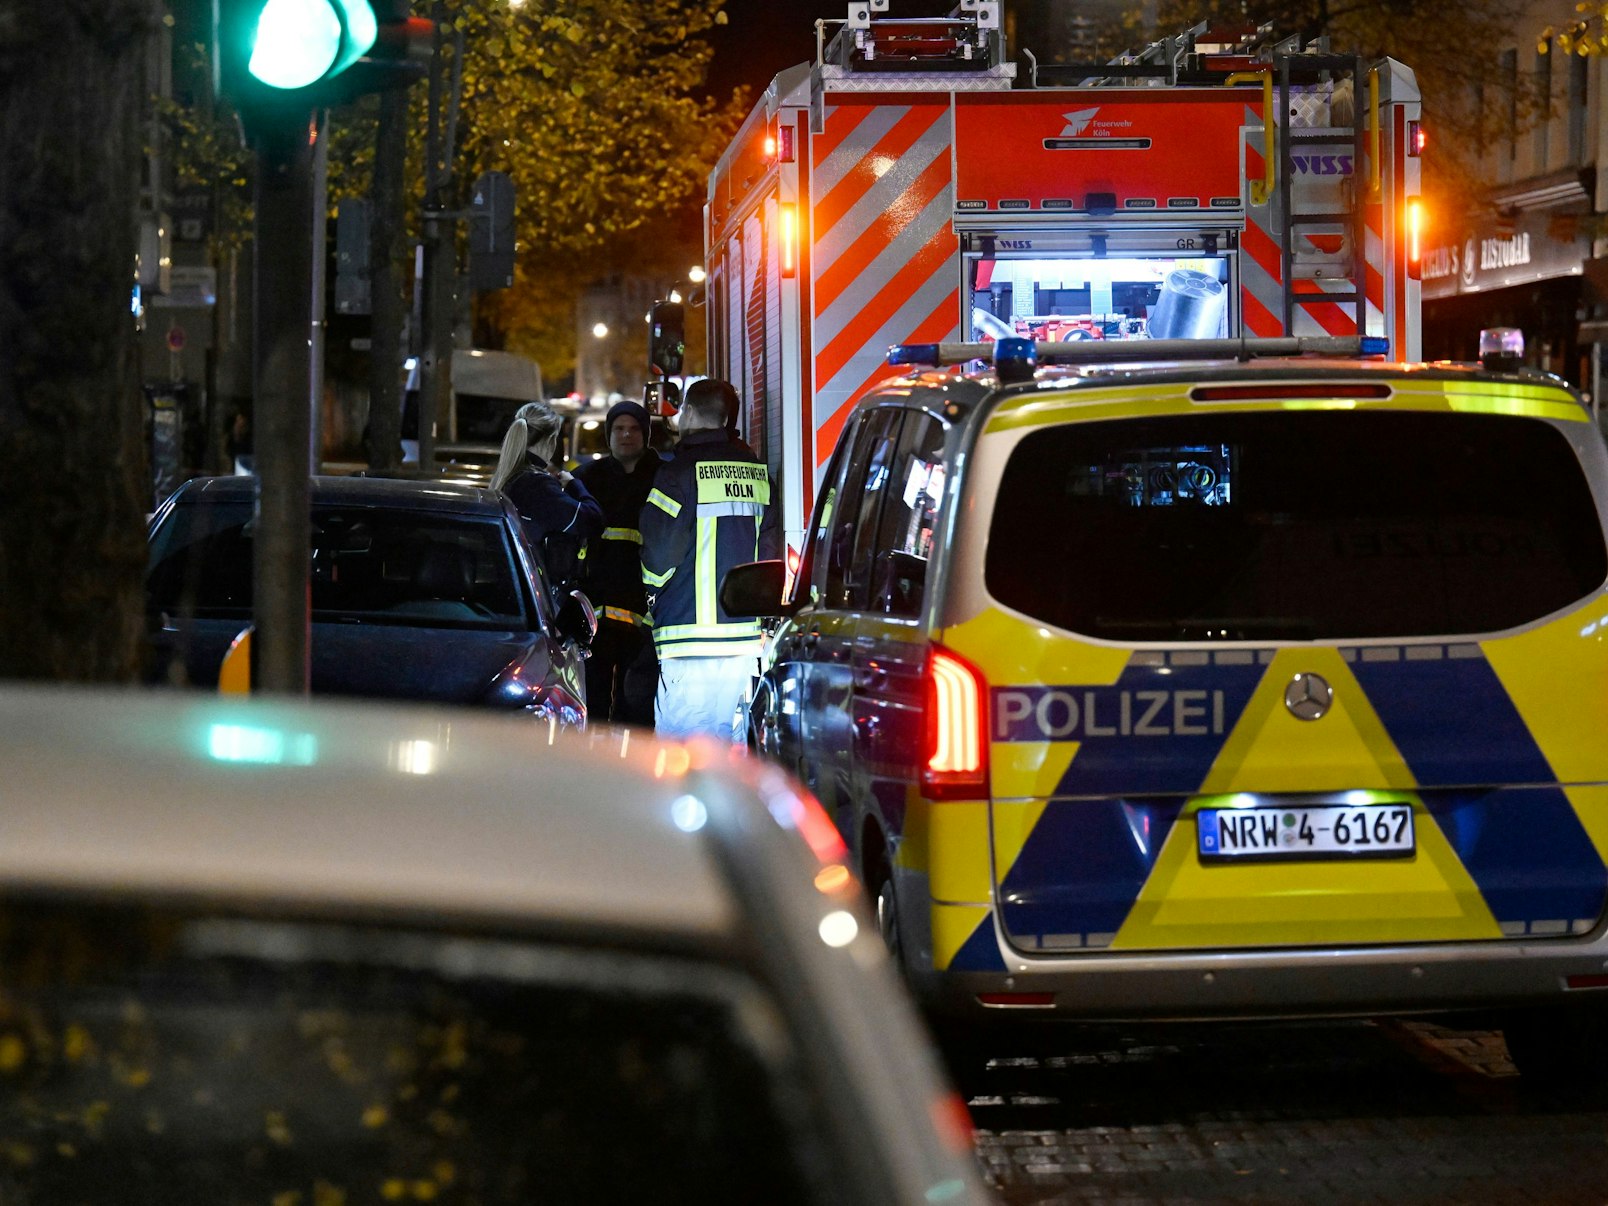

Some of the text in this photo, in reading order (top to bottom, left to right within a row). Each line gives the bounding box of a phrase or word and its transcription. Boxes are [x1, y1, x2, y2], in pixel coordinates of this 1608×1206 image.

[1177, 239, 1195, 250] GR
[699, 465, 767, 481] BERUFSFEUERWEHR
[725, 481, 754, 498] KÖLN
[998, 689, 1225, 738] POLIZEI
[1219, 810, 1409, 849] NRW 4-6167
